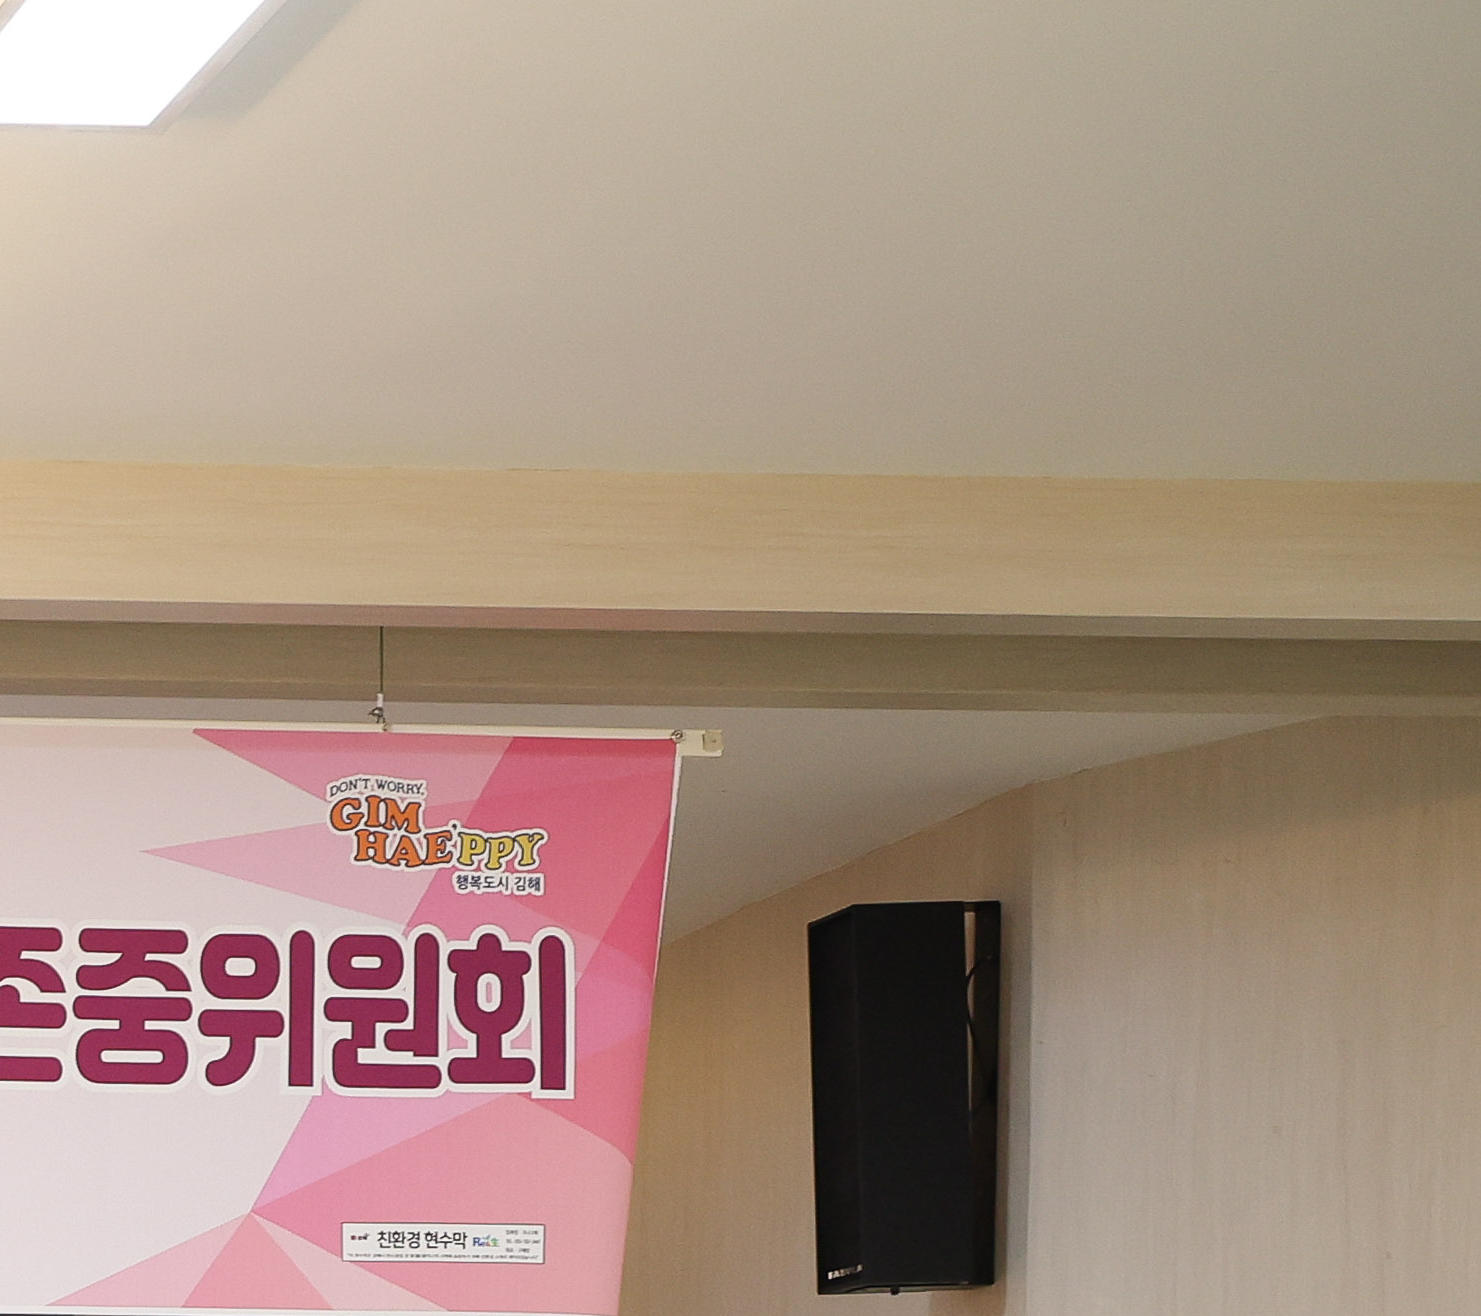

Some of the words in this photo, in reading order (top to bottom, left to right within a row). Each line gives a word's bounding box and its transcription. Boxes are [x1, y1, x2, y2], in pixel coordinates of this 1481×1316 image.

[329, 778, 372, 797] DON'T
[375, 779, 425, 795] WORRY,
[330, 795, 421, 833] GIM
[354, 823, 544, 870] HAE'PPY
[456, 875, 509, 891] 행복도시
[513, 876, 541, 892] 김해
[377, 1230, 421, 1249] 친환경
[424, 1231, 467, 1249] 현수막
